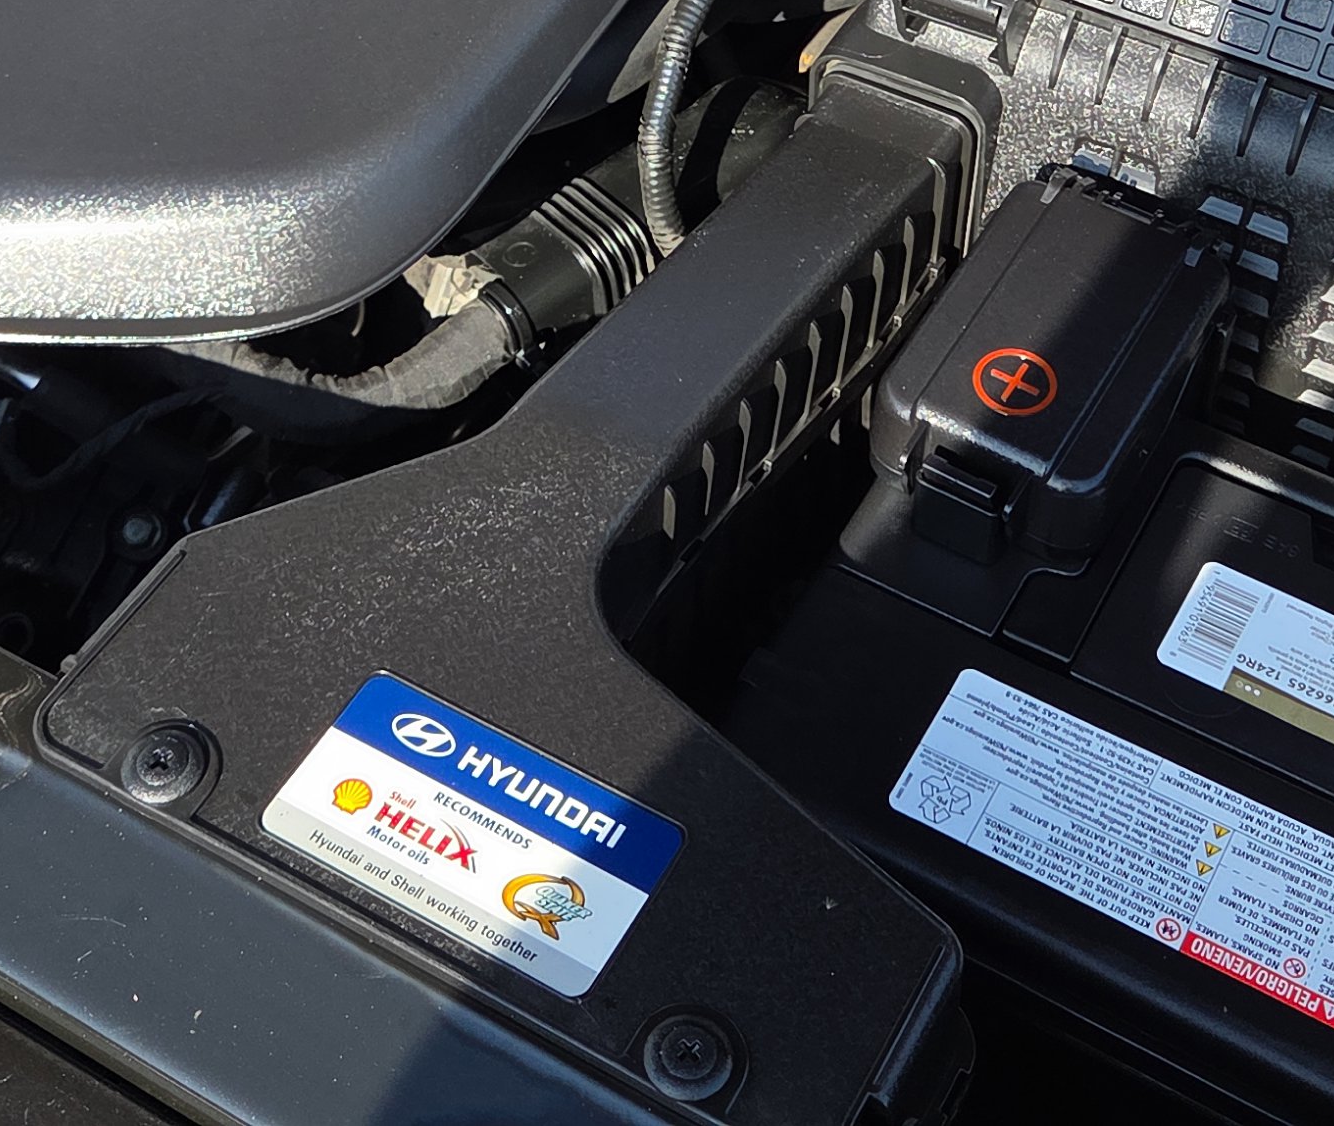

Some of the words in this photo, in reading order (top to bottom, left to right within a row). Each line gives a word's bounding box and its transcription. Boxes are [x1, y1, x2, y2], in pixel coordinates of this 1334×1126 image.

[1175, 612, 1200, 644] 01963
[1233, 650, 1283, 681] 124RG
[1157, 771, 1215, 804] RAPIDEMENT.
[1175, 768, 1212, 791] MEDICO.
[387, 789, 417, 810] Shell
[454, 745, 629, 850] HYUNDAI
[1211, 785, 1224, 797] EL
[1222, 790, 1243, 806] CON
[430, 790, 534, 851] RECOMMENDS
[1241, 799, 1276, 821] RAPIDO
[1236, 820, 1261, 837] FAST.
[1253, 816, 1270, 830] UN
[1275, 815, 1308, 836] ACUDA
[364, 823, 410, 854] Motor
[405, 844, 434, 866] oils
[371, 801, 483, 872] HELIX
[1259, 831, 1284, 848] HELP
[1268, 823, 1320, 853] CONSULTER
[989, 843, 1035, 871] CHILDREN.
[1228, 844, 1262, 866] GRAVES.
[1243, 839, 1280, 862] FUERTES.
[1282, 842, 1324, 867] MEDICAL
[1033, 864, 1047, 877] OF
[1045, 870, 1077, 892] REACH
[1277, 855, 1334, 888] QUEMADURAS
[307, 827, 366, 867] Hyundai
[361, 858, 393, 882] and
[388, 872, 427, 900] Shell
[424, 894, 480, 934] working
[480, 922, 539, 962] together
[1077, 886, 1096, 902] THE
[1282, 882, 1313, 904] BURNS.
[1299, 878, 1317, 893] DES
[1315, 885, 1329, 899] OU
[534, 882, 595, 922] QUAKER
[1094, 895, 1109, 908] OF
[1216, 893, 1248, 914] FUMER
[1228, 884, 1267, 910] FLAMAS,
[532, 893, 579, 924] STATE
[1107, 901, 1128, 918] OUT
[1245, 907, 1260, 920] DE
[1265, 902, 1305, 928] CHISPAS,
[1281, 898, 1325, 925] CIGARROS
[1126, 911, 1152, 929] KEEP
[1258, 912, 1304, 941] FLAMMES,
[1303, 921, 1320, 936] NO
[1192, 919, 1230, 945] FLAMES,
[1301, 934, 1315, 947] DE
[1227, 937, 1265, 962] SPARKS,
[1241, 932, 1283, 958] SMOKING
[1289, 941, 1311, 958] PAS
[1188, 934, 1322, 1013] PELIGRO/VENENO
[1263, 955, 1280, 970] NO
